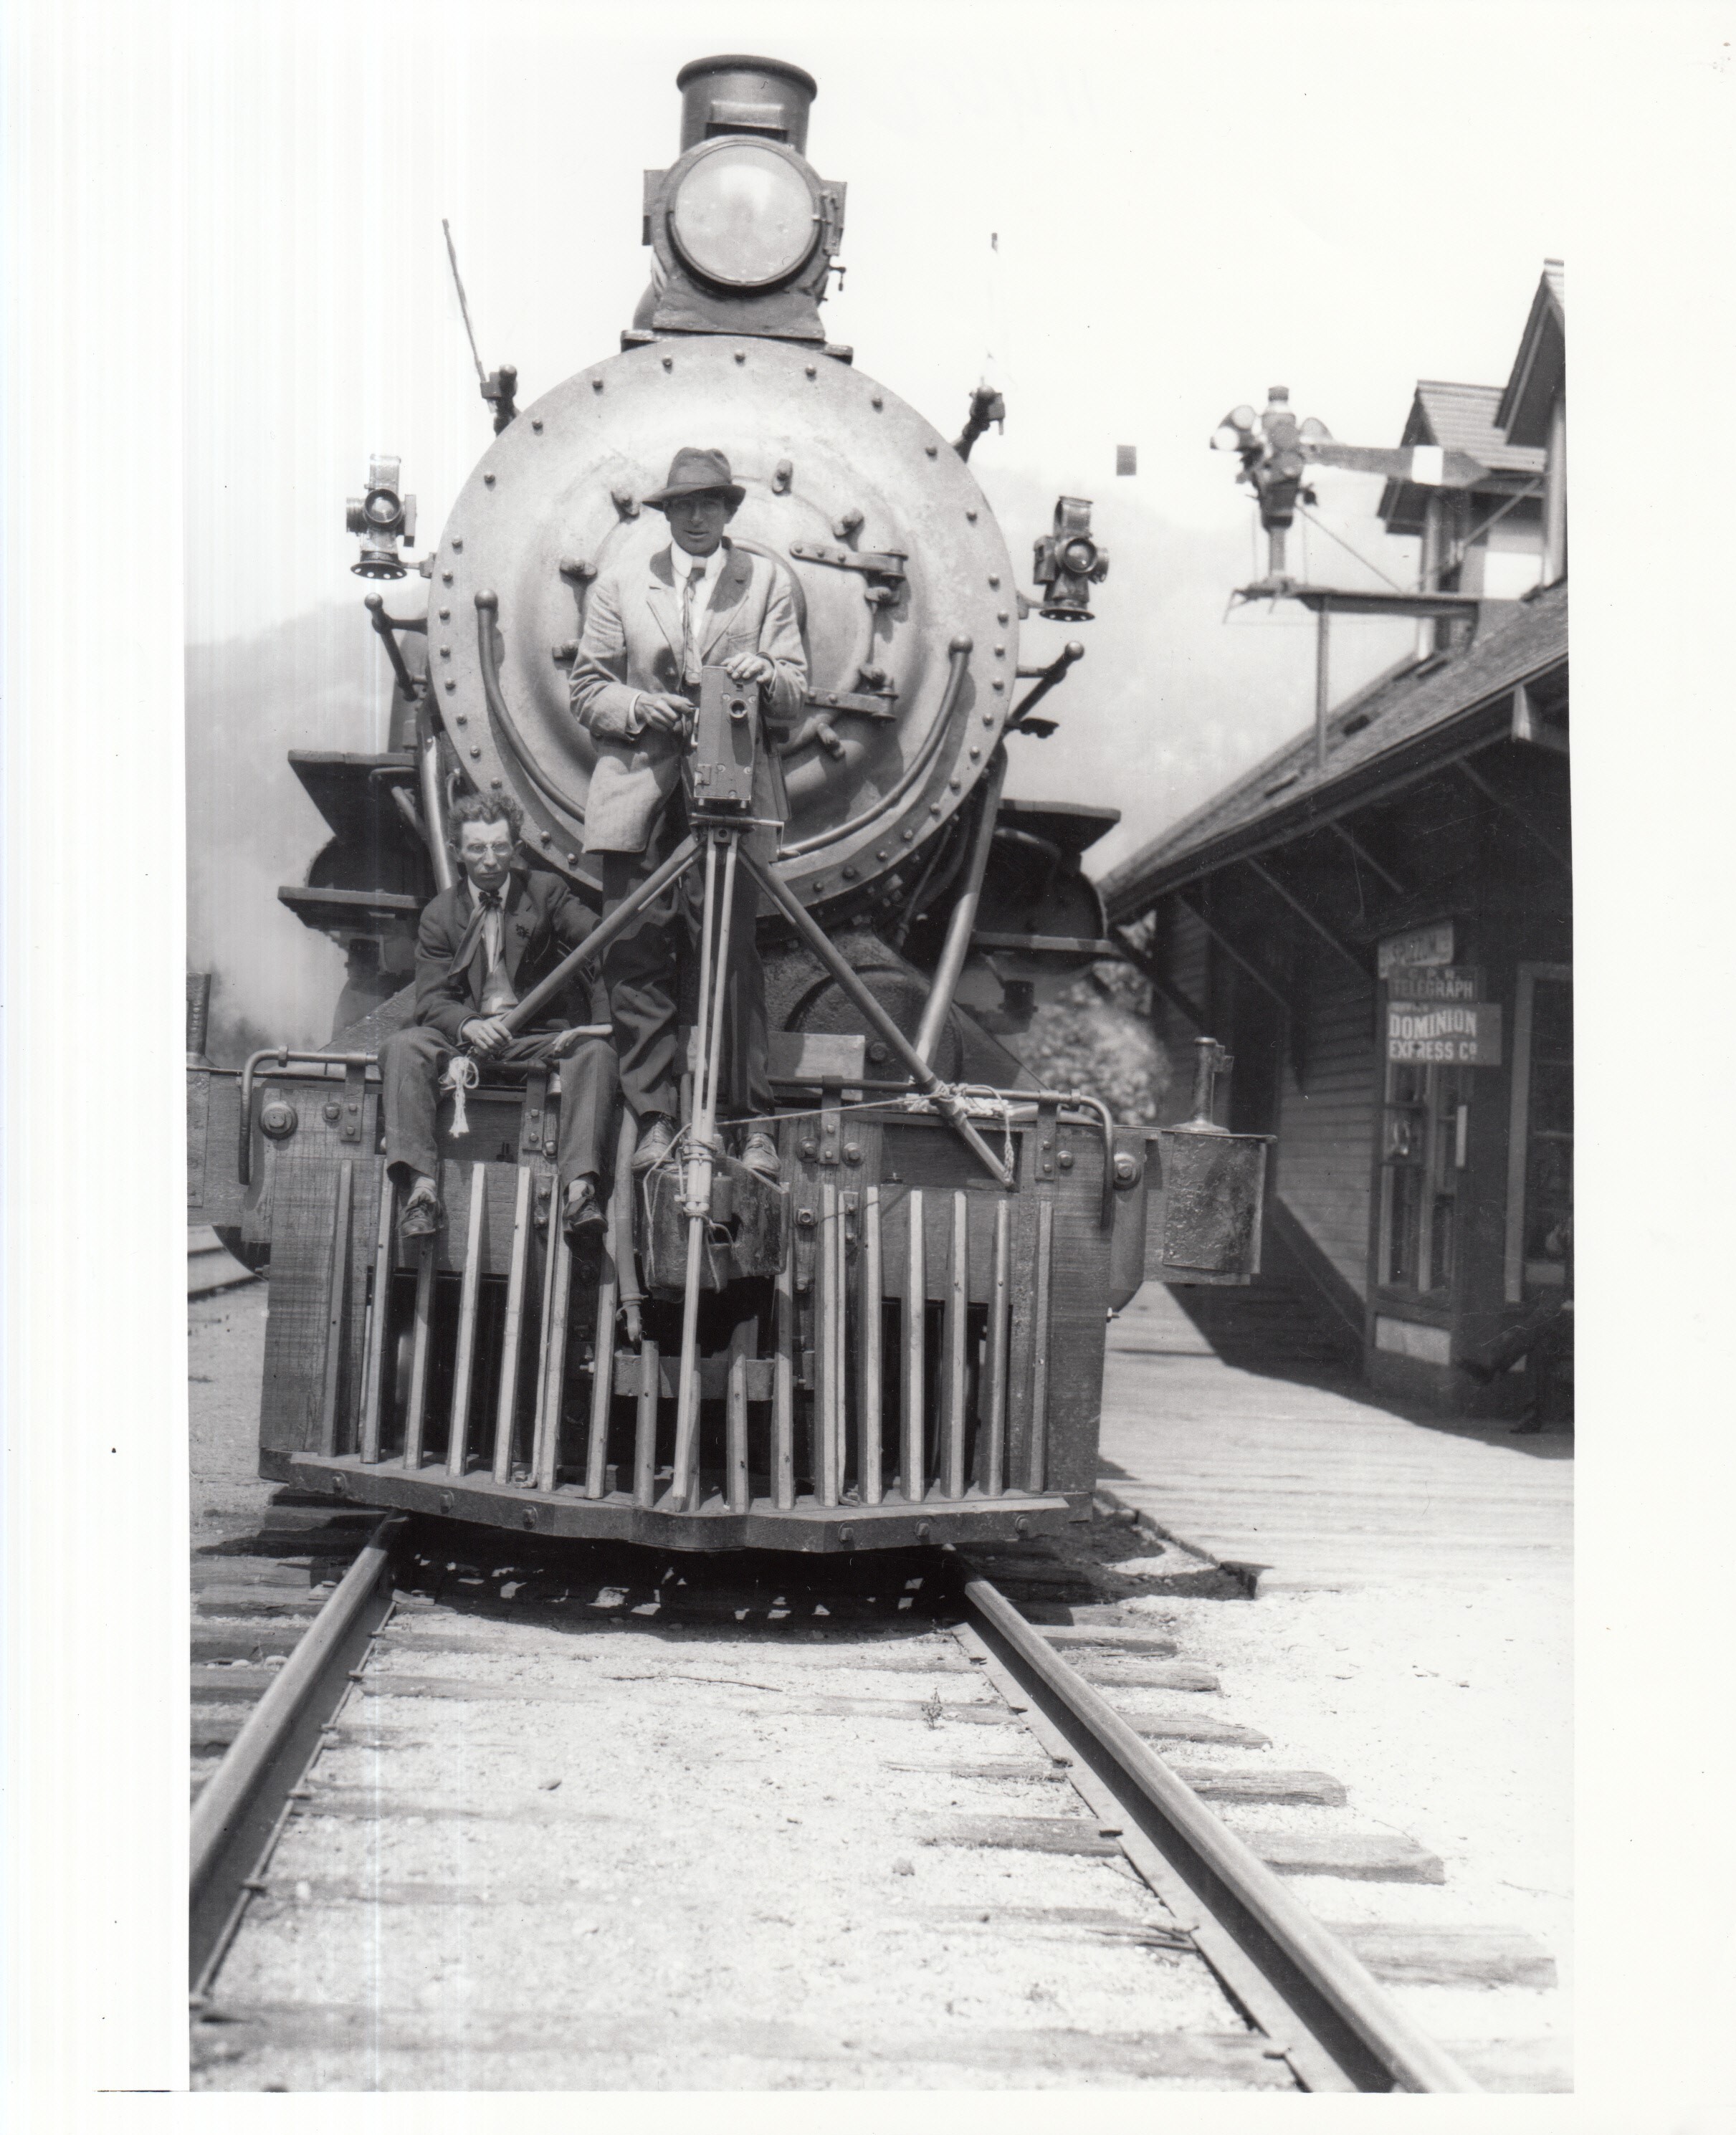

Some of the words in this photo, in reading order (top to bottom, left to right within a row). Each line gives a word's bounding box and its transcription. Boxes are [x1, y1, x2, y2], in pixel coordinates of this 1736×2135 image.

[1393, 979, 1474, 999] TELEGRAPH
[1388, 1008, 1477, 1039] DOMINION
[1388, 1040, 1454, 1061] EXPRESS
